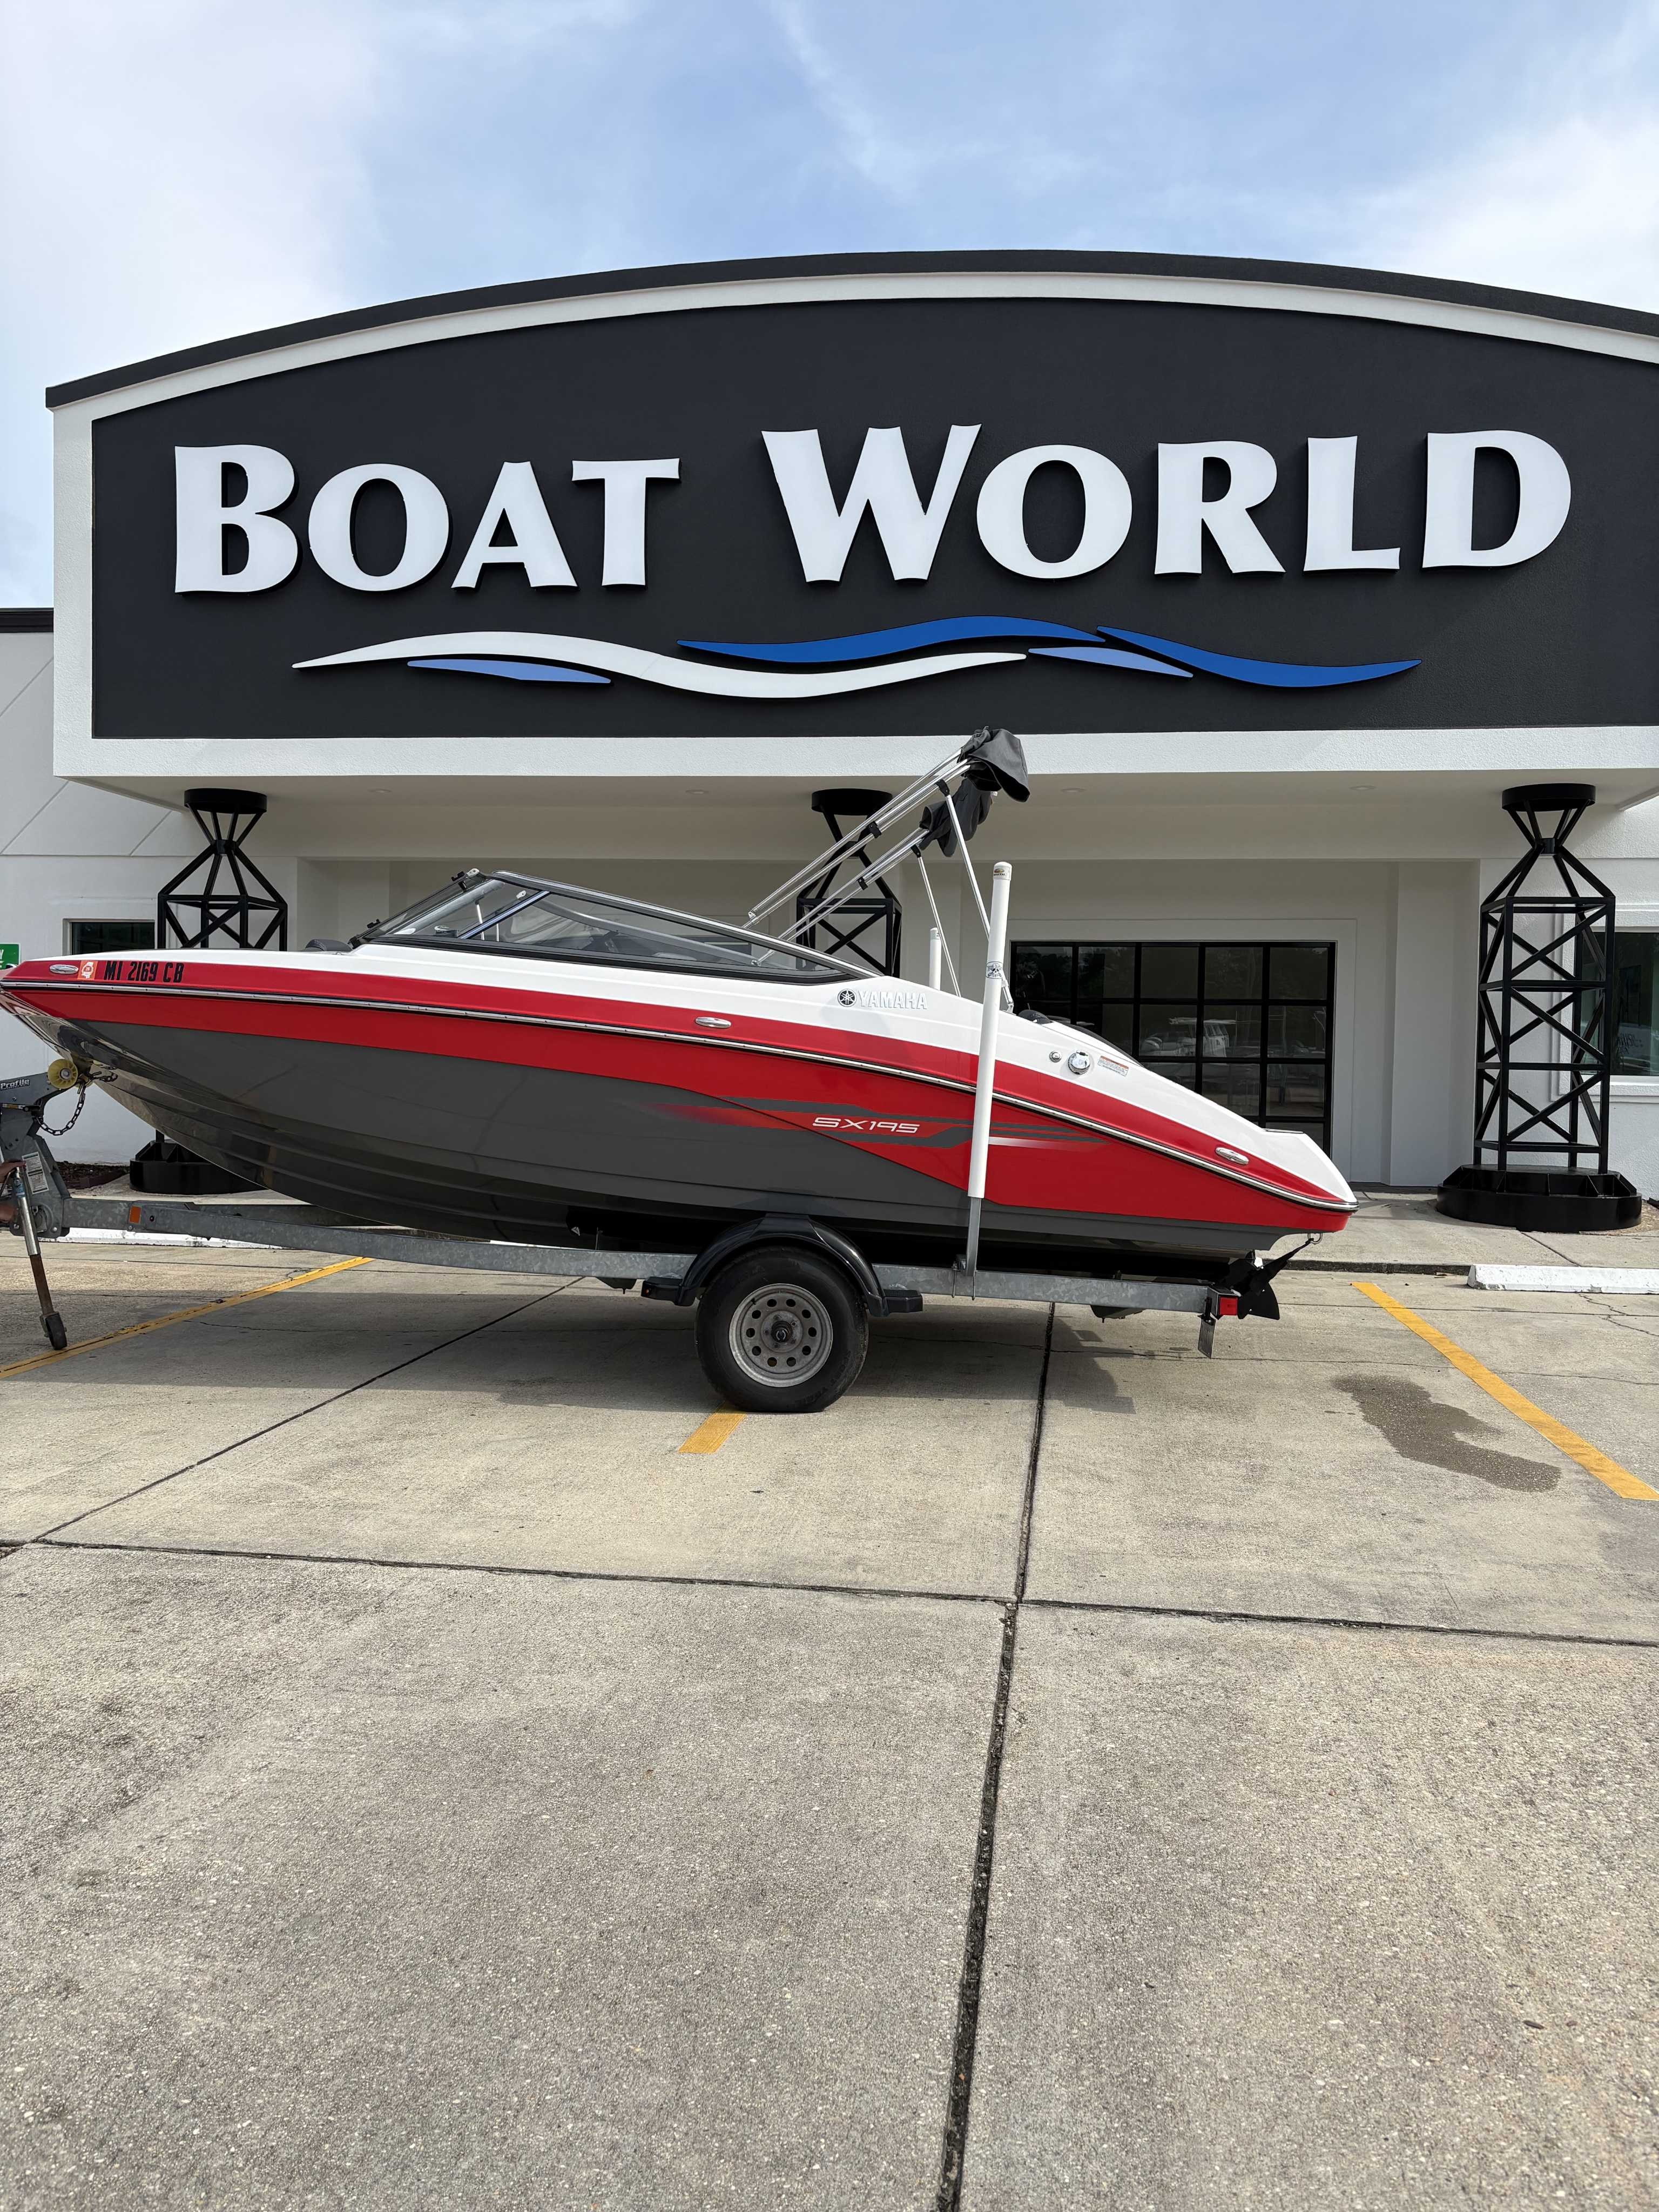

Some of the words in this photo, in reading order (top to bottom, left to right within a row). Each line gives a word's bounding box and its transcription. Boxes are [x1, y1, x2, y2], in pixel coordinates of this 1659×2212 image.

[175, 444, 680, 593] BOAT
[760, 424, 1572, 583] WORLD
[103, 960, 123, 981] MI
[127, 961, 159, 982] 2169
[163, 962, 184, 983] CB
[858, 989, 928, 1010] YAMAHA
[0, 1079, 30, 1090] Profile
[812, 1117, 920, 1134] SX195
